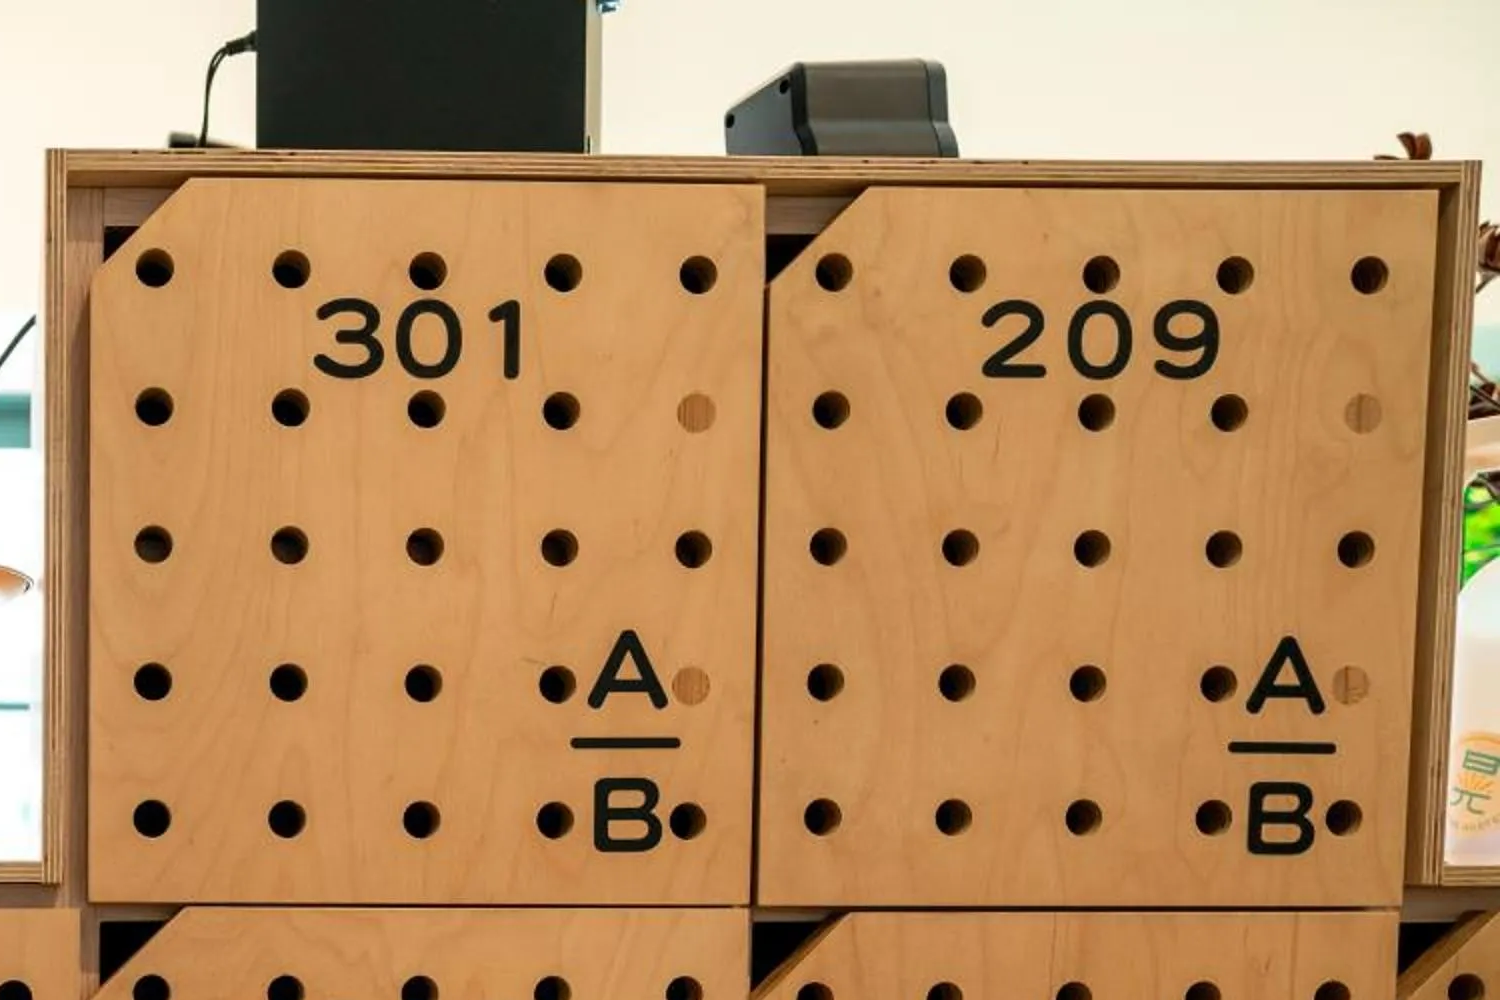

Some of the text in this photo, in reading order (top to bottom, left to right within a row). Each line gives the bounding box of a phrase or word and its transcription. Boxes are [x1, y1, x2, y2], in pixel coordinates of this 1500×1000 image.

[312, 297, 522, 381] 301
[980, 298, 1221, 382] 209
[587, 628, 670, 711] A
[1244, 634, 1327, 716] A
[592, 776, 664, 854] B
[1245, 780, 1317, 856] B
